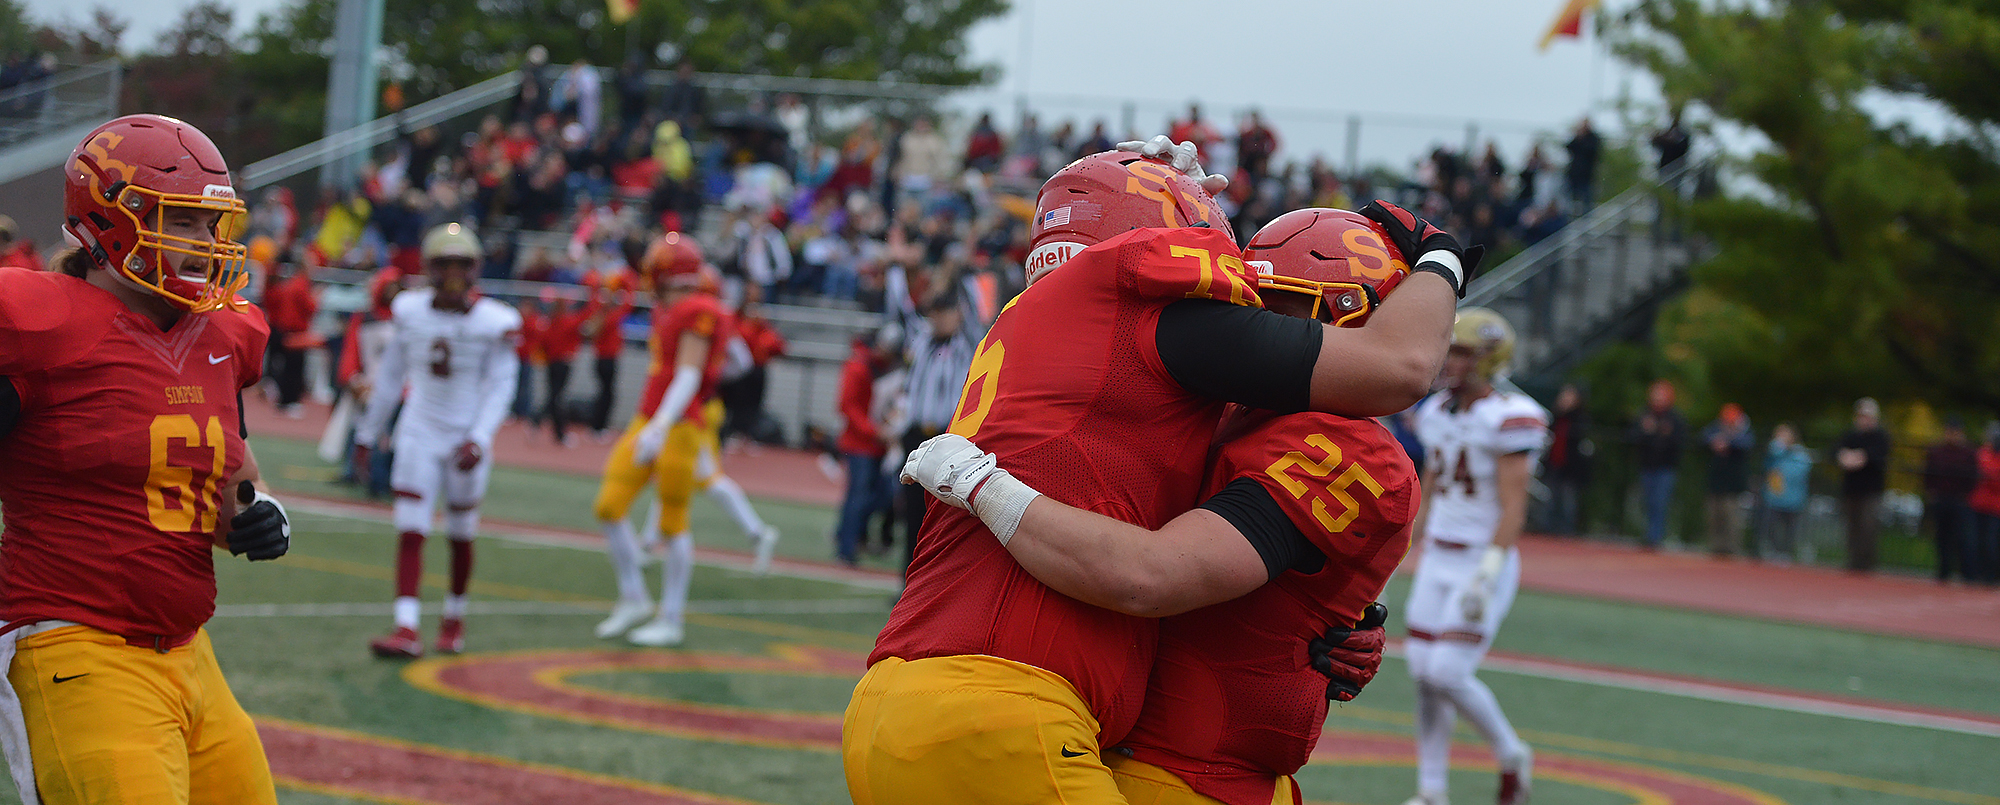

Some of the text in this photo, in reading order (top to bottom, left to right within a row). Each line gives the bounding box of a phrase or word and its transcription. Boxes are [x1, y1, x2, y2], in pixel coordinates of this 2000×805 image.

[1169, 244, 1262, 308] 76
[164, 385, 205, 405] SIMPSON
[143, 413, 226, 534] 61
[1265, 433, 1385, 533] 25
